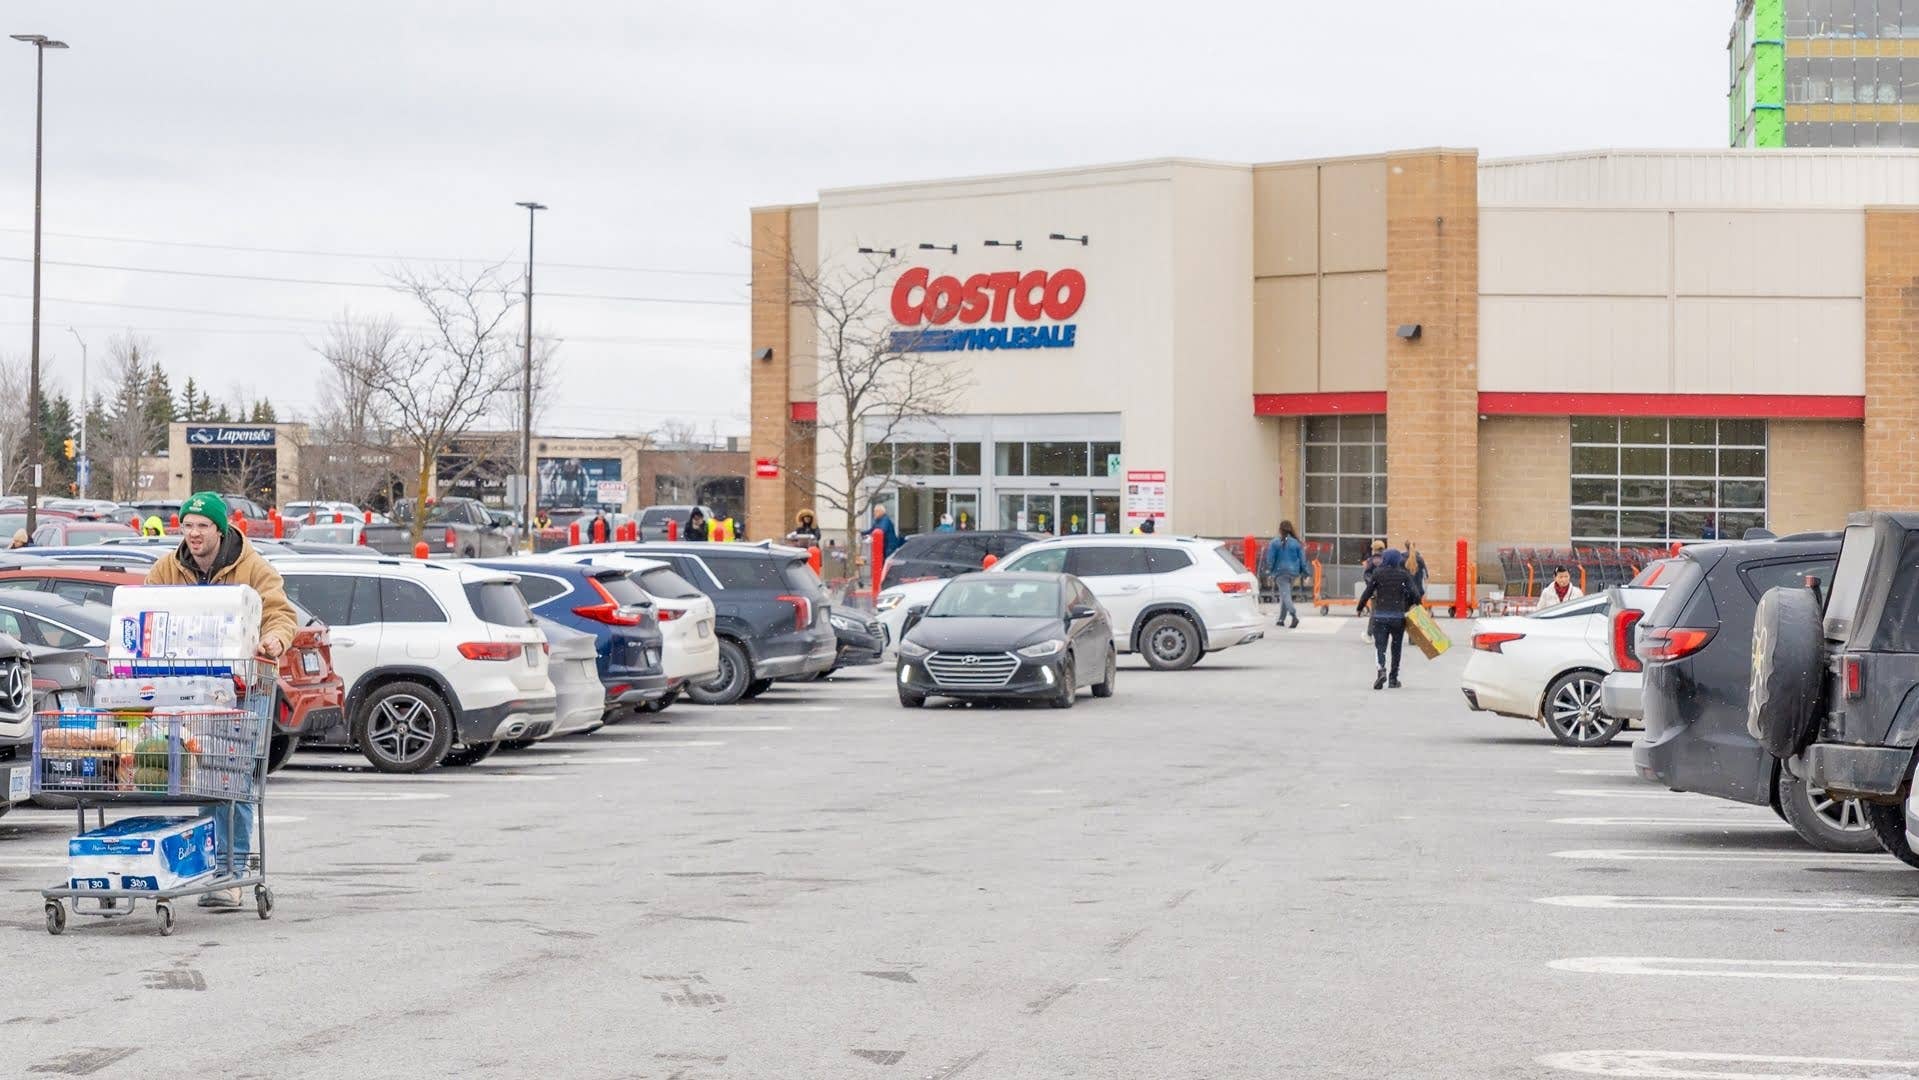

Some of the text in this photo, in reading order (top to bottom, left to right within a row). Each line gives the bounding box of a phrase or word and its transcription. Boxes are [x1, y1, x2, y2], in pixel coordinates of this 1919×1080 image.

[890, 267, 1086, 326] COSTCO
[950, 324, 1077, 352] WHOLESALE
[91, 880, 103, 888] 30
